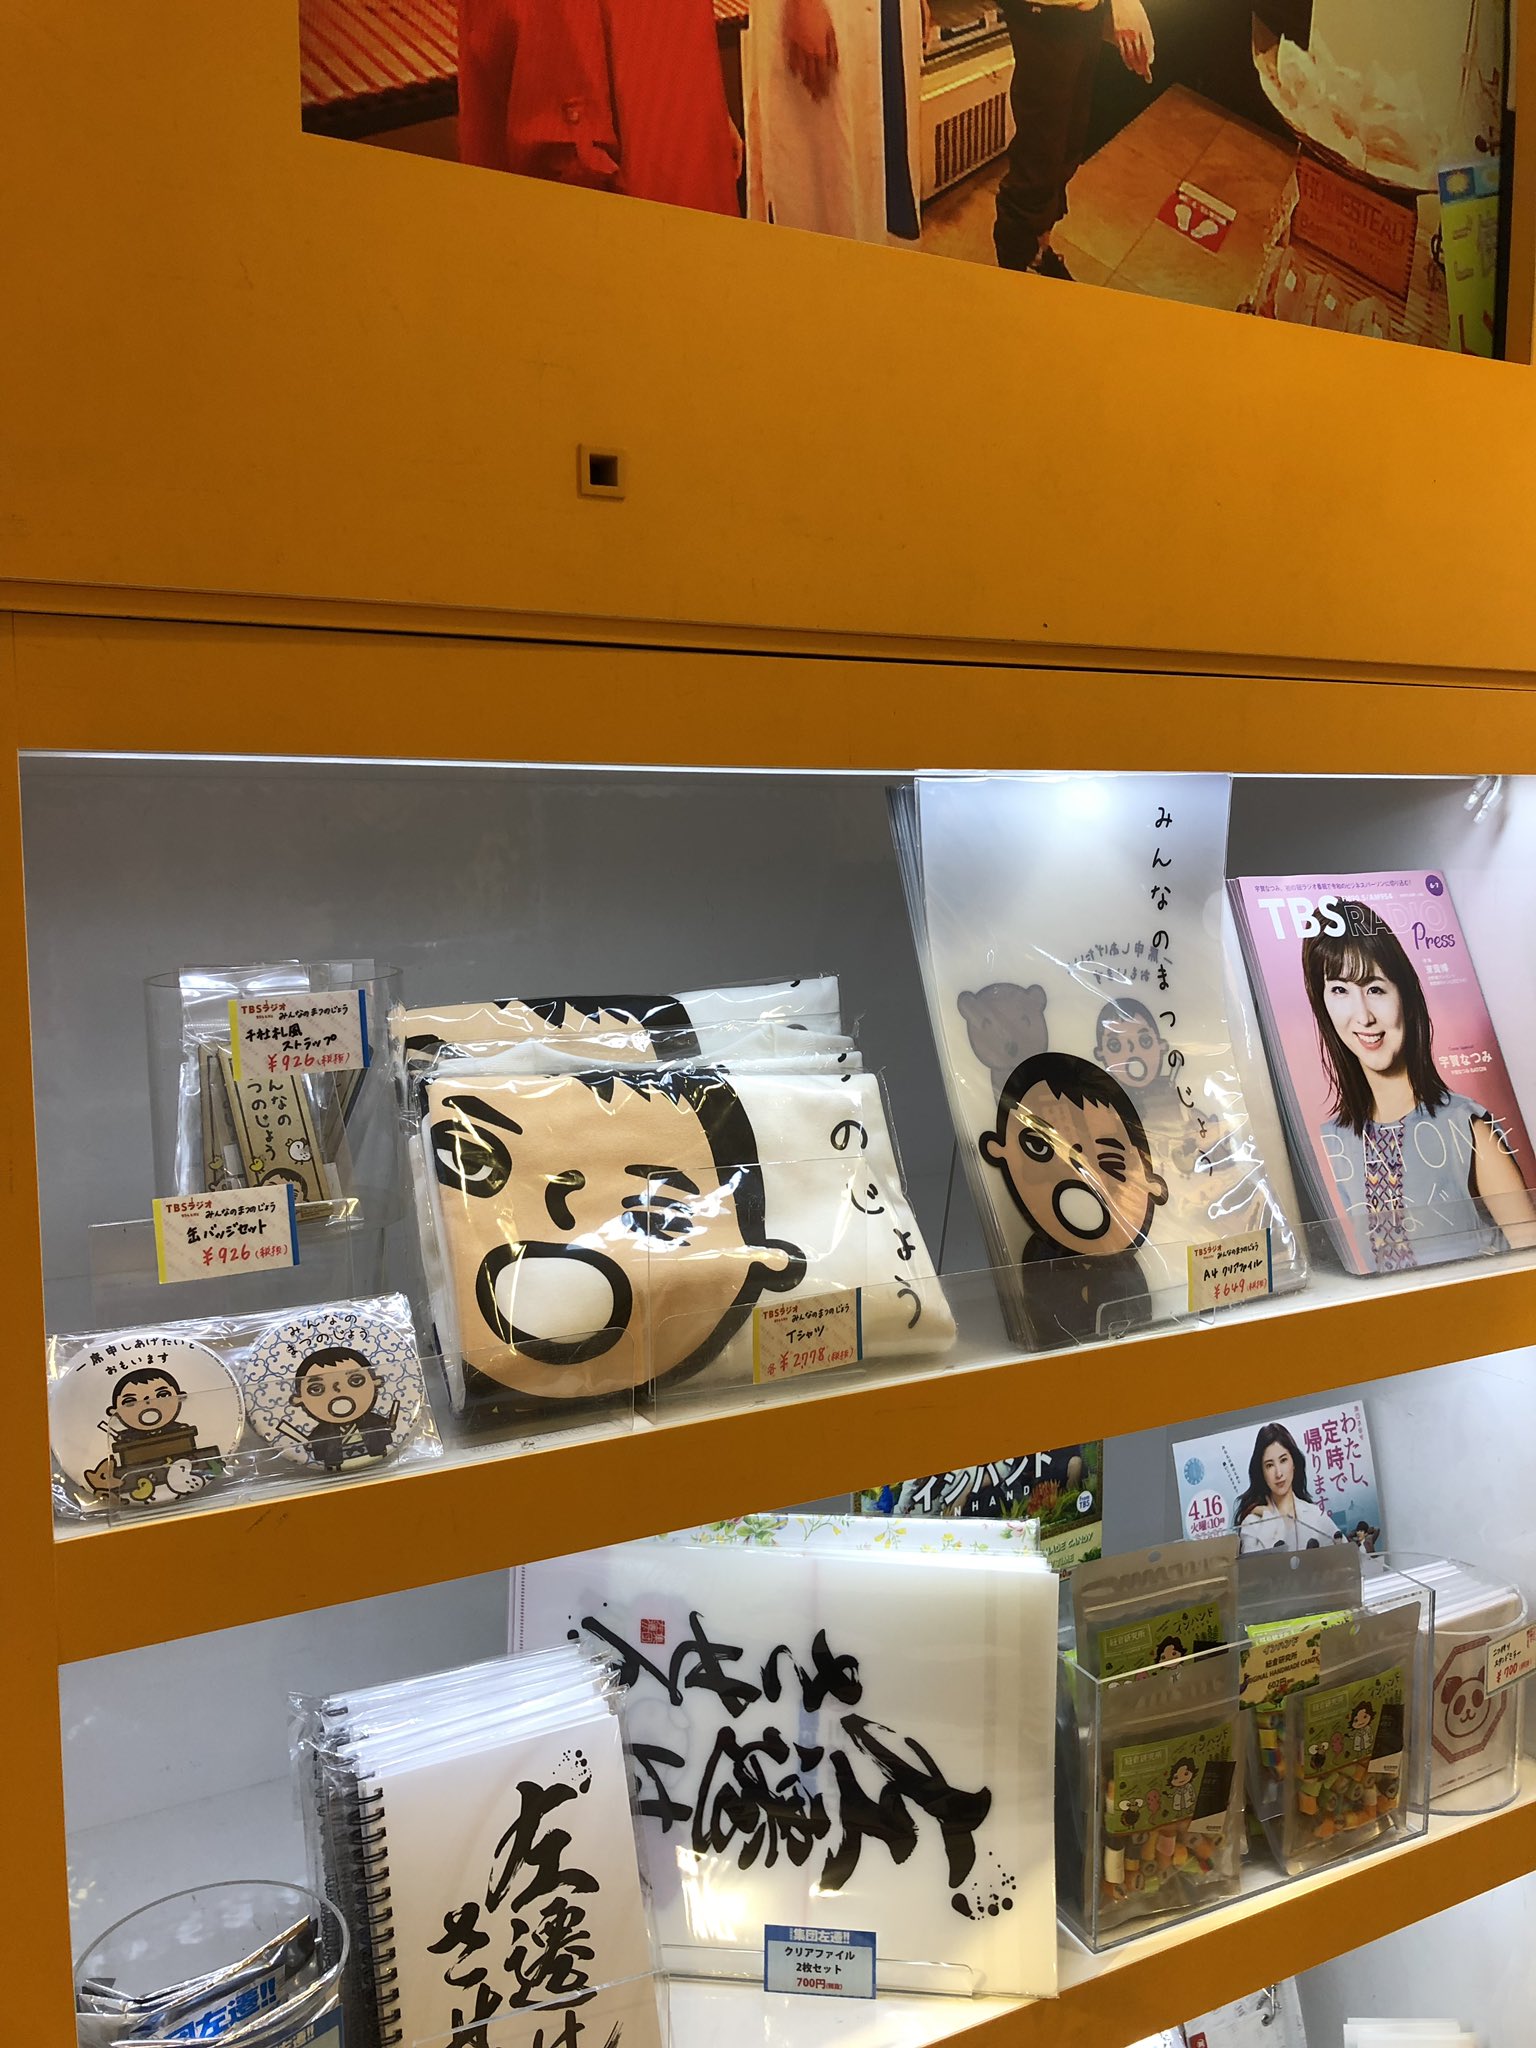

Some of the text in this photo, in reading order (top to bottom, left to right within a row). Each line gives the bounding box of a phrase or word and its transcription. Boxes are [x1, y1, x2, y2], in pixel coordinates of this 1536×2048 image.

[1258, 895, 1456, 951] TBS RADIO Press
[1150, 805, 1213, 1177] みんなのまつのじょう
[241, 1000, 287, 1014] TBSラジオ
[278, 1003, 349, 1021] みんなのまつのじょう
[245, 1022, 303, 1043] 千社札風
[282, 1033, 338, 1052] ストラップ
[1438, 1050, 1493, 1069] 宇賀なつみ
[166, 1197, 213, 1214] TBSラジオ
[205, 1201, 277, 1219] みんなのまつのじょう
[1345, 1182, 1455, 1237] つなぐ
[186, 1218, 267, 1244] 缶バッジセット
[1194, 1243, 1223, 1257] TBSラジオ
[1216, 1241, 1259, 1260] みんなのまつのじょう
[763, 1303, 799, 1320] TBSラジオ
[791, 1303, 850, 1323] みんなのまつのじょう
[287, 1314, 358, 1337] みんなの
[785, 1325, 825, 1344] Tシャツ
[286, 1327, 368, 1356] まつのじょう
[76, 1337, 196, 1372] 一席申しあげたいと
[105, 1352, 169, 1375] おもいます
[1321, 1419, 1348, 1493] 定時で
[1340, 1412, 1369, 1487] わたし、
[911, 1452, 1052, 1513] インハンド
[1303, 1427, 1333, 1518] 帰ります。
[971, 1485, 1032, 1512] HAND
[1079, 1499, 1091, 1510] TBS
[1188, 1494, 1223, 1521] 4.16
[1247, 1672, 1269, 1684] RIGINAL
[784, 1946, 856, 1960] クリアファイル
[796, 1963, 842, 1975] 2枚セット
